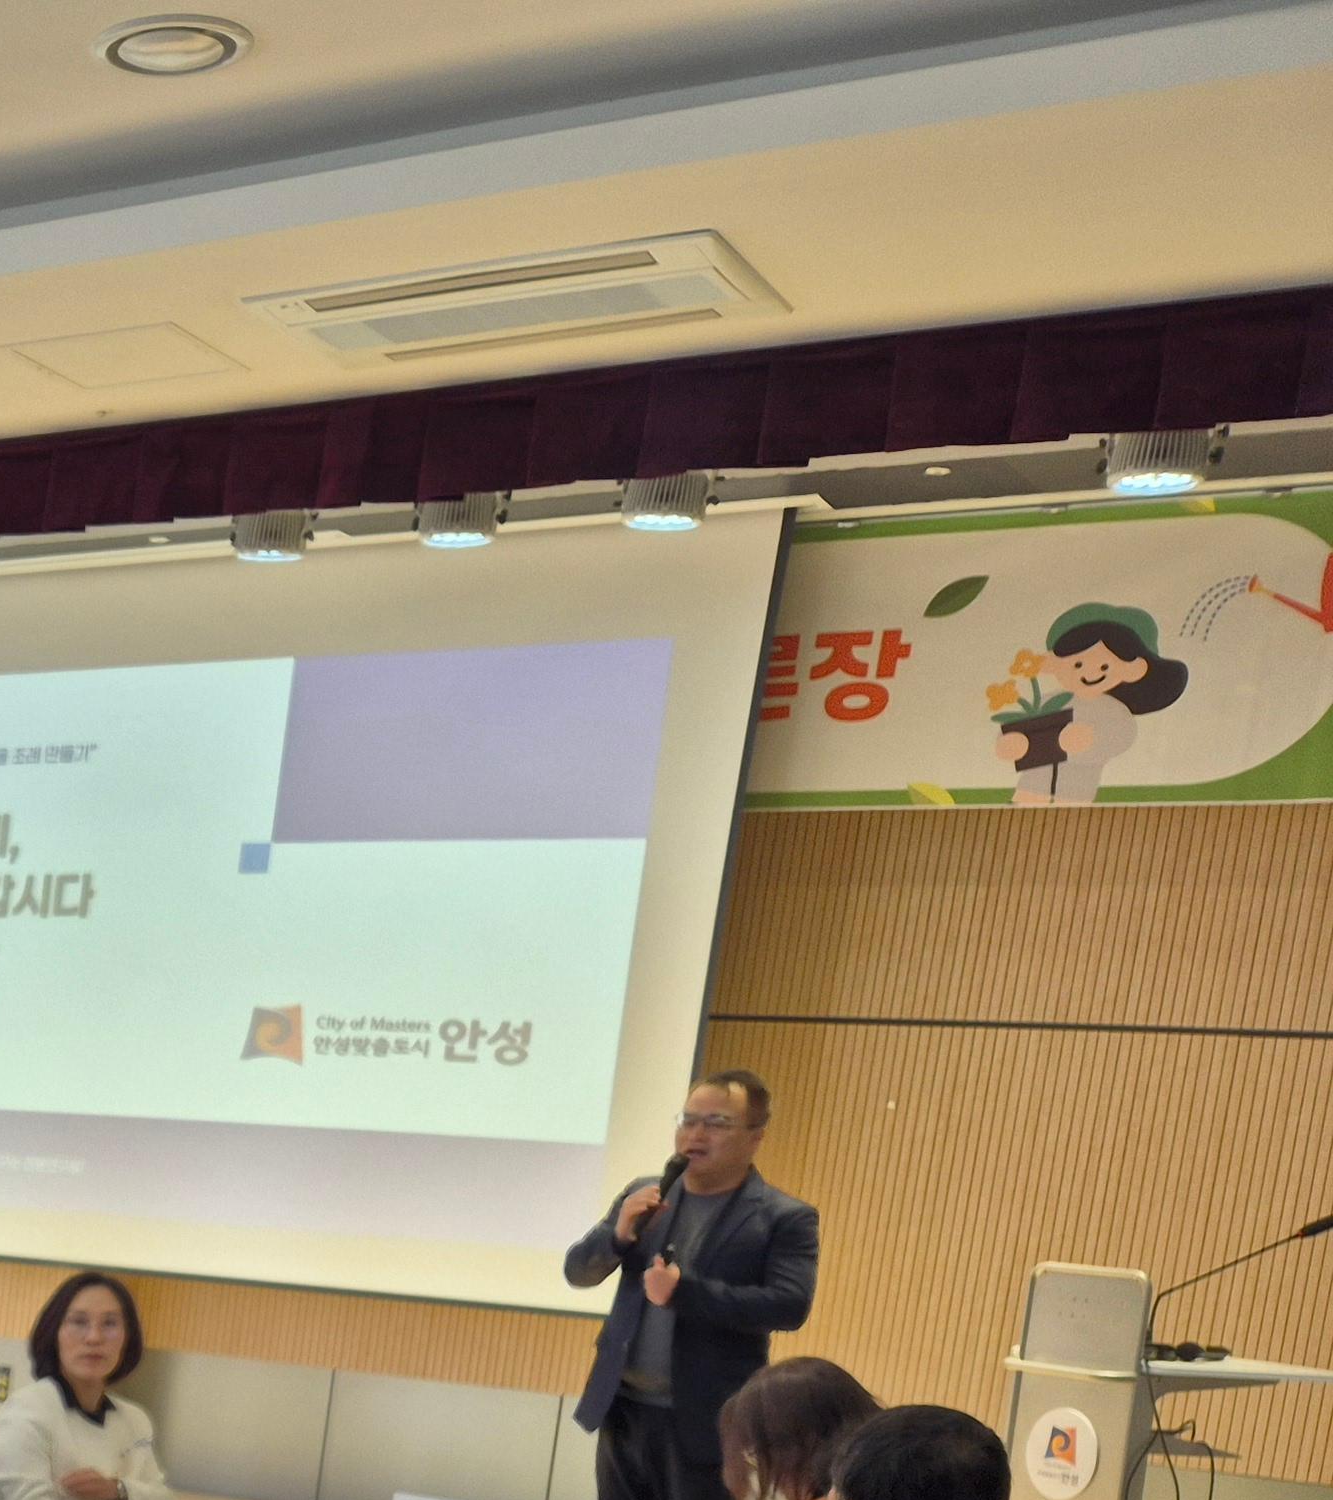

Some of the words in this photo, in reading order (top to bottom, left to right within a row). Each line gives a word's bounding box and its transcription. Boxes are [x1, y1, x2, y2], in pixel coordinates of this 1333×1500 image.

[316, 1014, 346, 1034] City
[350, 1015, 367, 1031] of
[370, 1015, 432, 1033] Masters
[313, 1034, 431, 1059] 안성맞춤도시
[438, 1018, 533, 1067] 안성
